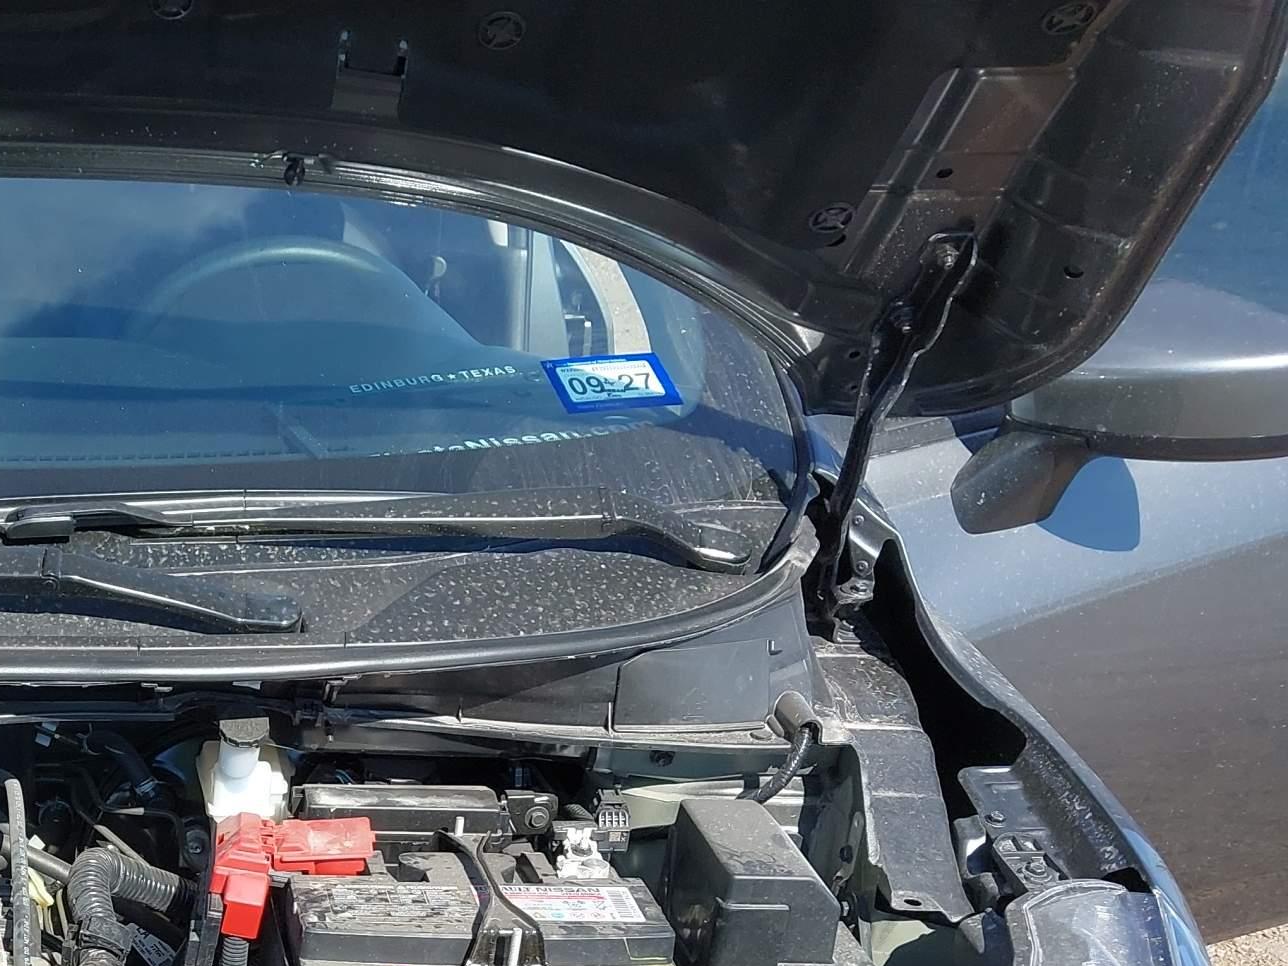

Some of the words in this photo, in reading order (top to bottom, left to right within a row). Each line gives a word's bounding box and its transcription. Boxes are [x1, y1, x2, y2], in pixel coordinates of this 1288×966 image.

[349, 374, 444, 394] EDINBURG
[459, 365, 516, 380] TEXAS
[567, 375, 605, 395] 09
[617, 372, 650, 391] 27
